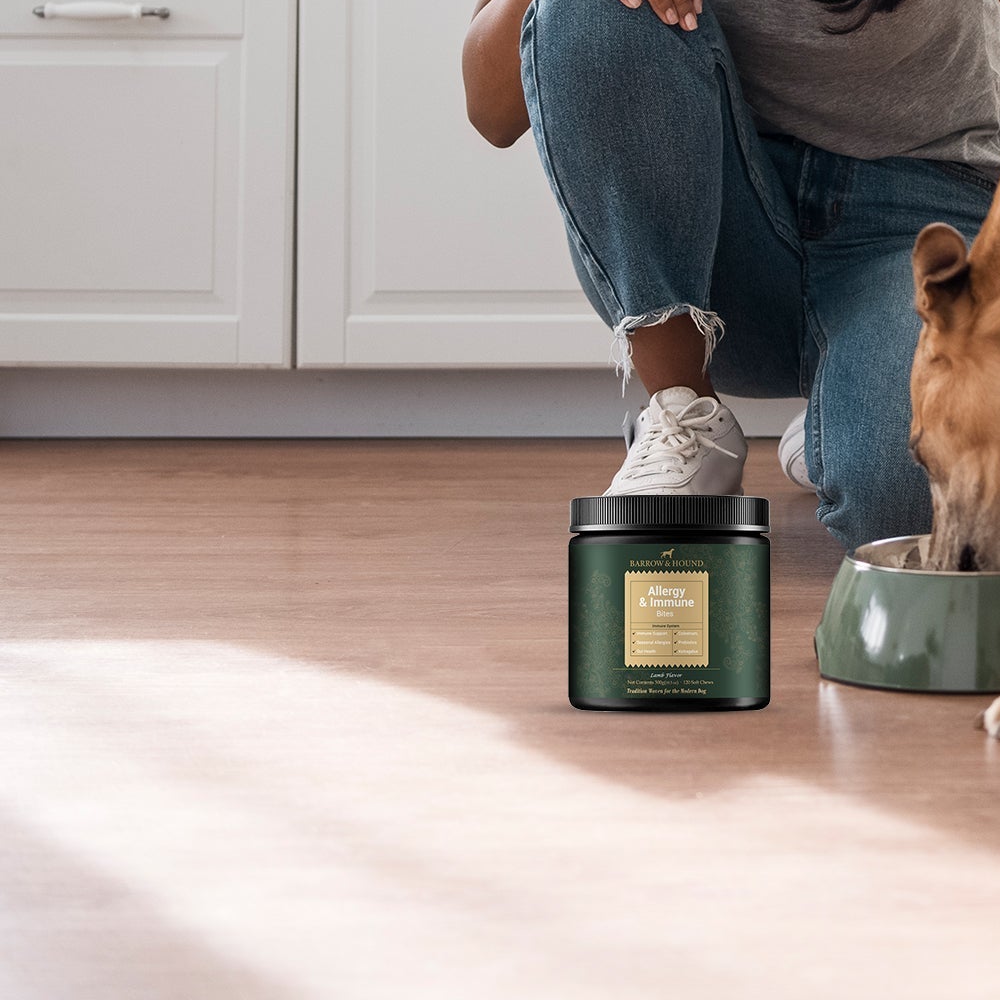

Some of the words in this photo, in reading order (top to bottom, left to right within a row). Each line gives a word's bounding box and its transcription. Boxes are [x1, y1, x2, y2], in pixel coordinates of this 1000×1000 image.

[630, 559, 663, 567] BARROW
[664, 559, 671, 567] &
[672, 559, 704, 567] HOUND
[648, 585, 686, 599] Allergy
[639, 597, 647, 608] &
[650, 597, 695, 608] Immune
[656, 609, 674, 617] Bites
